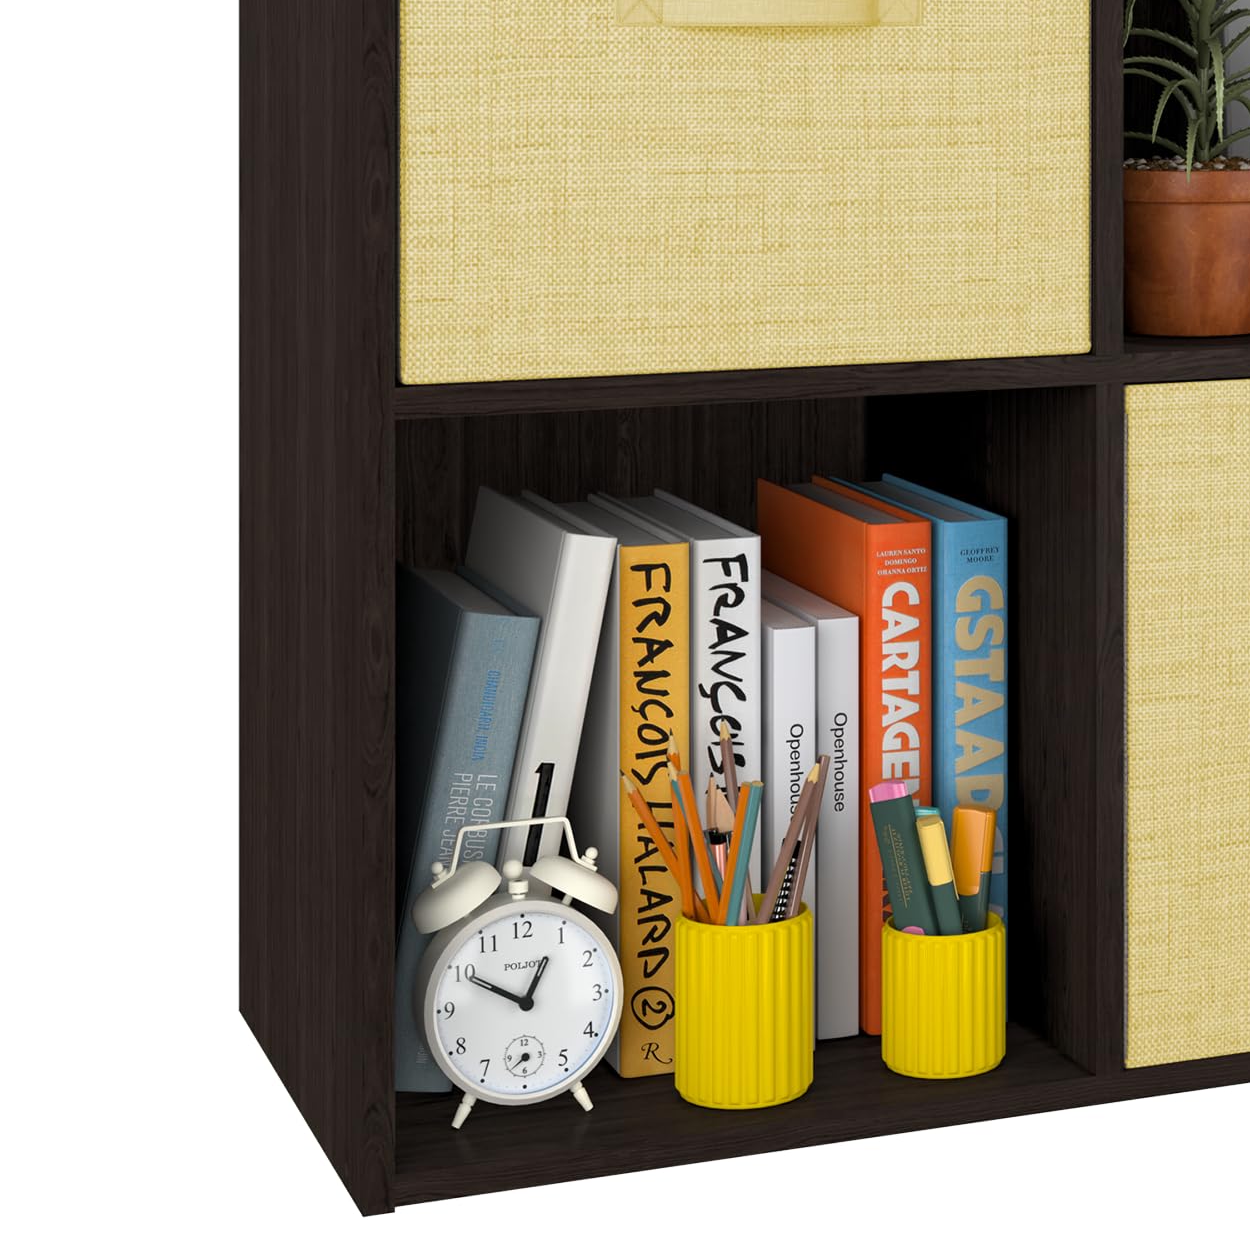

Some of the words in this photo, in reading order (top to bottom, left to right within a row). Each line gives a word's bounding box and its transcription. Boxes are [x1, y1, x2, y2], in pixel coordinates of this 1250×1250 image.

[884, 557, 917, 566] DOMINGO
[966, 555, 992, 563] MOORE
[631, 562, 675, 786] FRANÇOIS
[955, 575, 1005, 810] GSTAAD
[830, 711, 848, 813] Openhouse
[476, 773, 498, 791] LE
[444, 772, 474, 824] PIERRE
[512, 920, 533, 939] 12
[557, 926, 565, 944] 1
[479, 934, 498, 953] 11
[504, 959, 542, 971] POLJOT
[582, 950, 594, 968] 2
[454, 963, 476, 983] 10
[592, 983, 602, 1001] 3
[444, 1001, 455, 1020] 9
[583, 1021, 594, 1038] 4
[456, 1037, 466, 1055] 8
[519, 1038, 529, 1047] 12
[558, 1048, 568, 1067] 5
[480, 1058, 491, 1078] 7
[522, 1066, 528, 1075] 6
